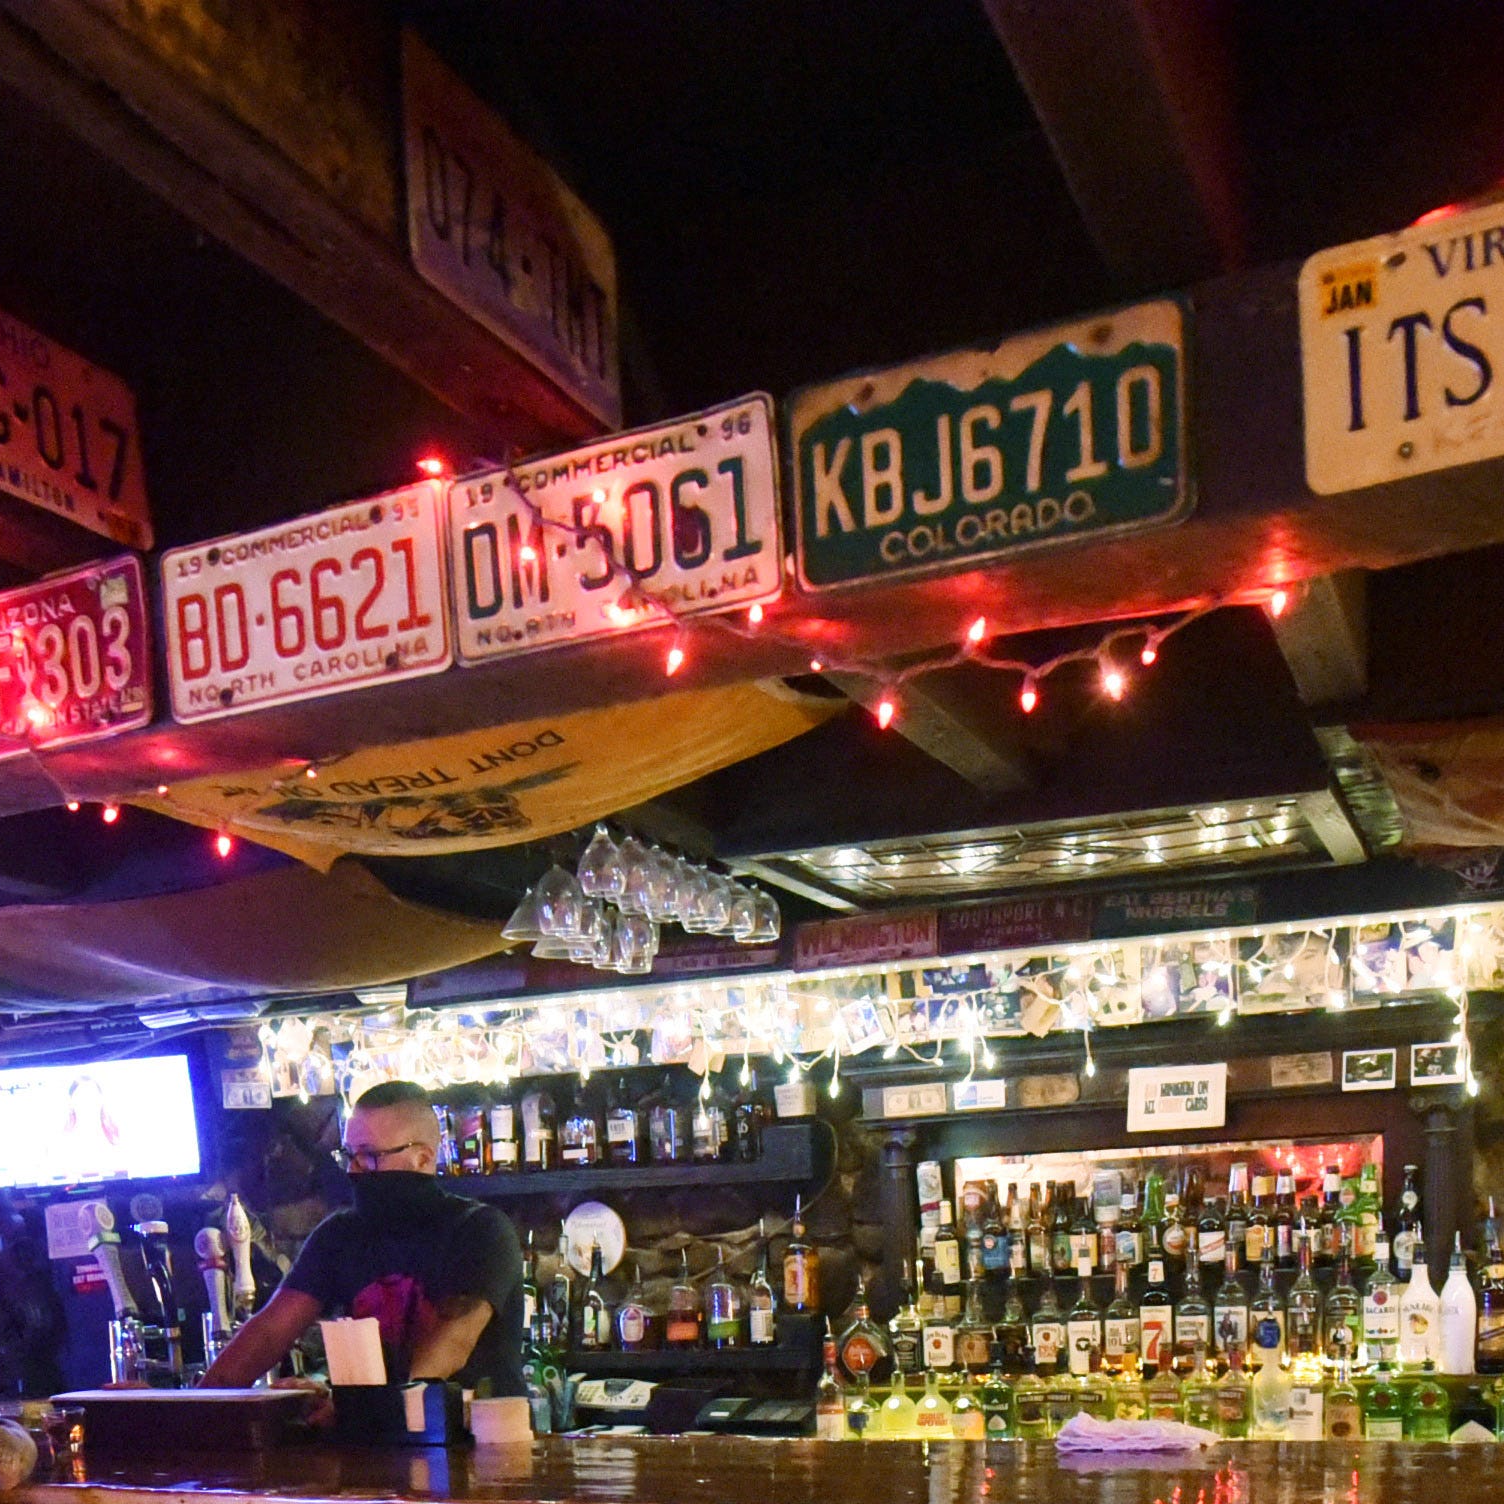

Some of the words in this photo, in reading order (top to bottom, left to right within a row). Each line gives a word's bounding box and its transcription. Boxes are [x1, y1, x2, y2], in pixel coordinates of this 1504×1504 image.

[1325, 279, 1373, 314] JAN
[1342, 296, 1494, 432] ITS
[516, 434, 694, 494] COMMERCIAL
[812, 364, 1162, 538] KBJ6710
[176, 556, 202, 578] 19
[220, 515, 369, 566] COMMERCIAL
[880, 491, 1096, 563] COLORADO
[476, 611, 577, 646] NORTH
[188, 671, 276, 704] NORTH
[293, 636, 430, 682] CAROLINA
[466, 729, 566, 775] DONT
[329, 765, 460, 797] TREAD
[1125, 900, 1229, 920] MUSSELS
[1143, 1320, 1164, 1361] 7
